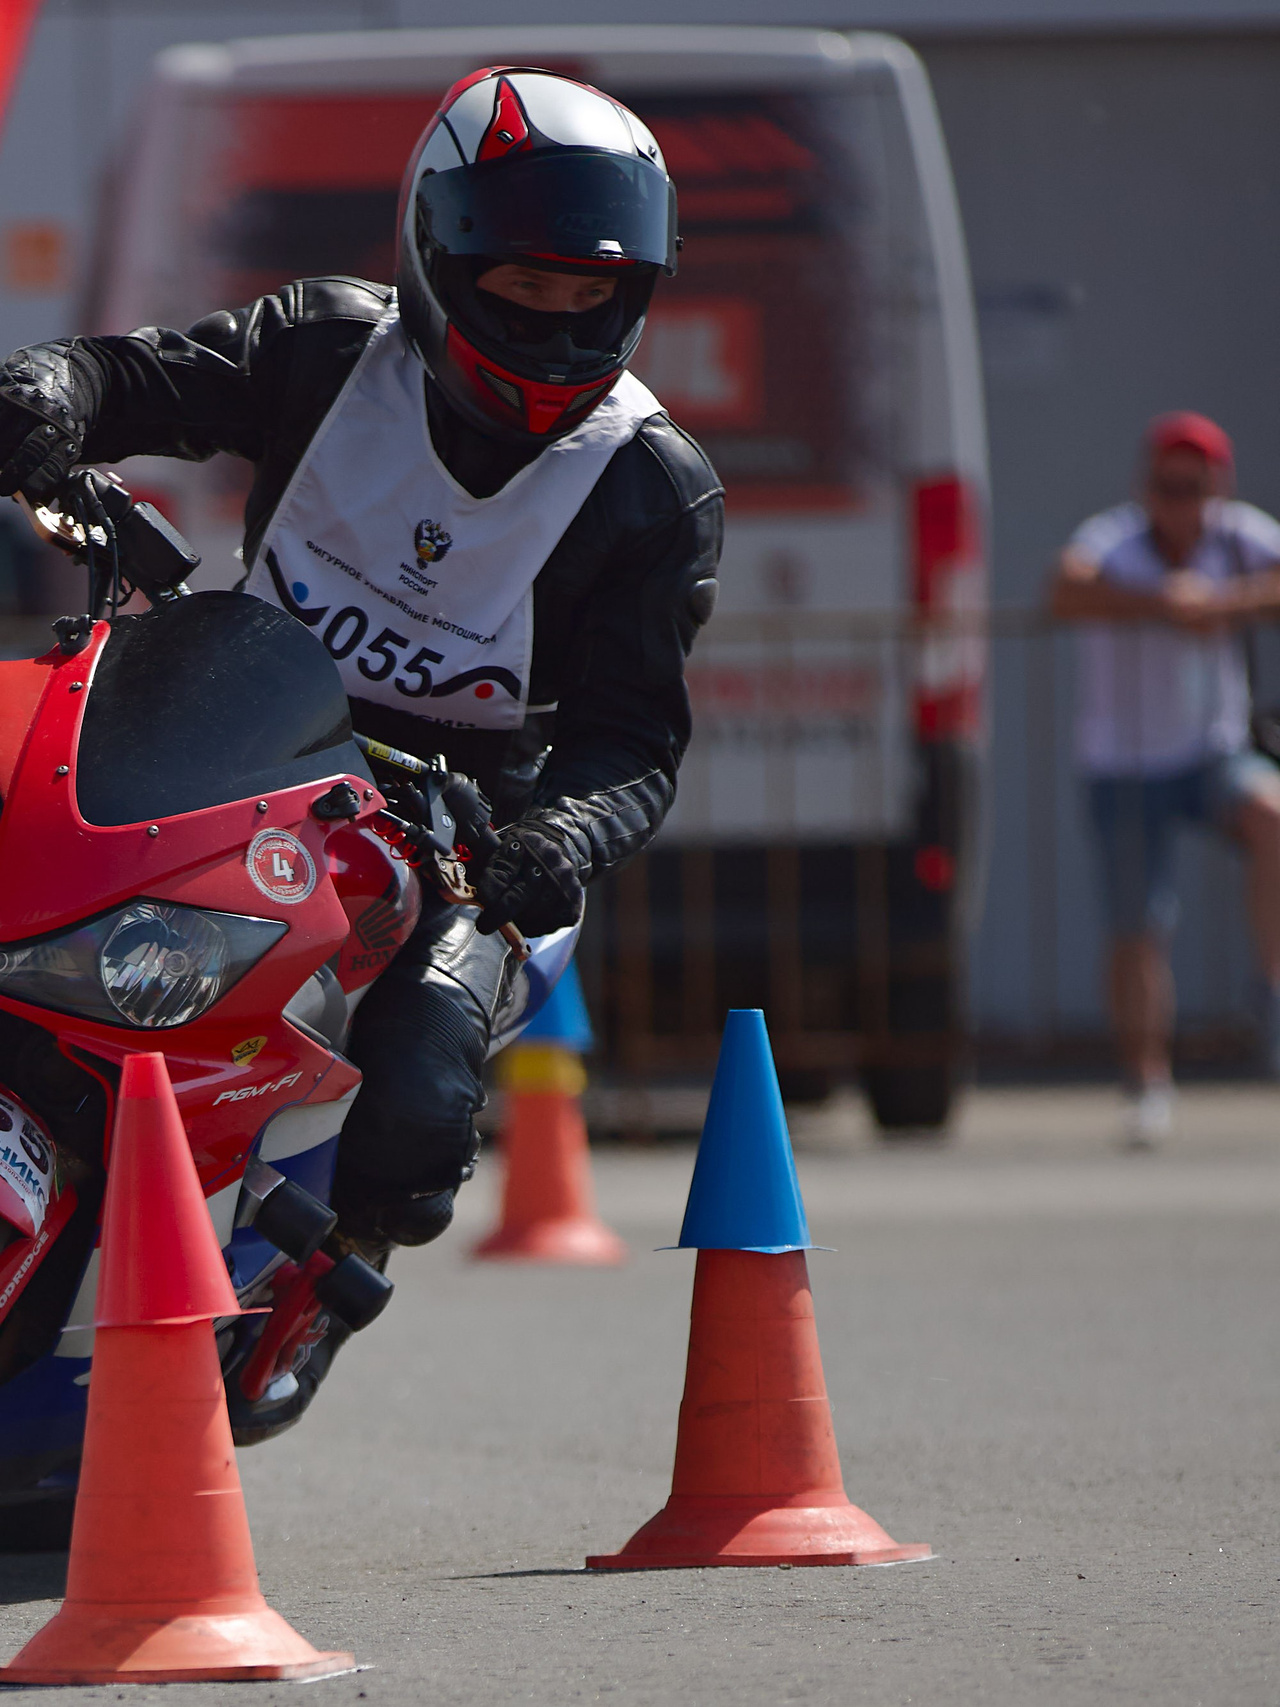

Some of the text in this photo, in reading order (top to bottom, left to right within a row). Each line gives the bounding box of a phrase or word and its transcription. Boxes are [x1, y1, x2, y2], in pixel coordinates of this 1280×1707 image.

[306, 540, 362, 581] ФИГУРНОЕ
[399, 574, 429, 597] РОССИИ
[400, 562, 438, 589] МИНСПОРТ
[322, 606, 446, 699] 055
[272, 853, 295, 882] 4
